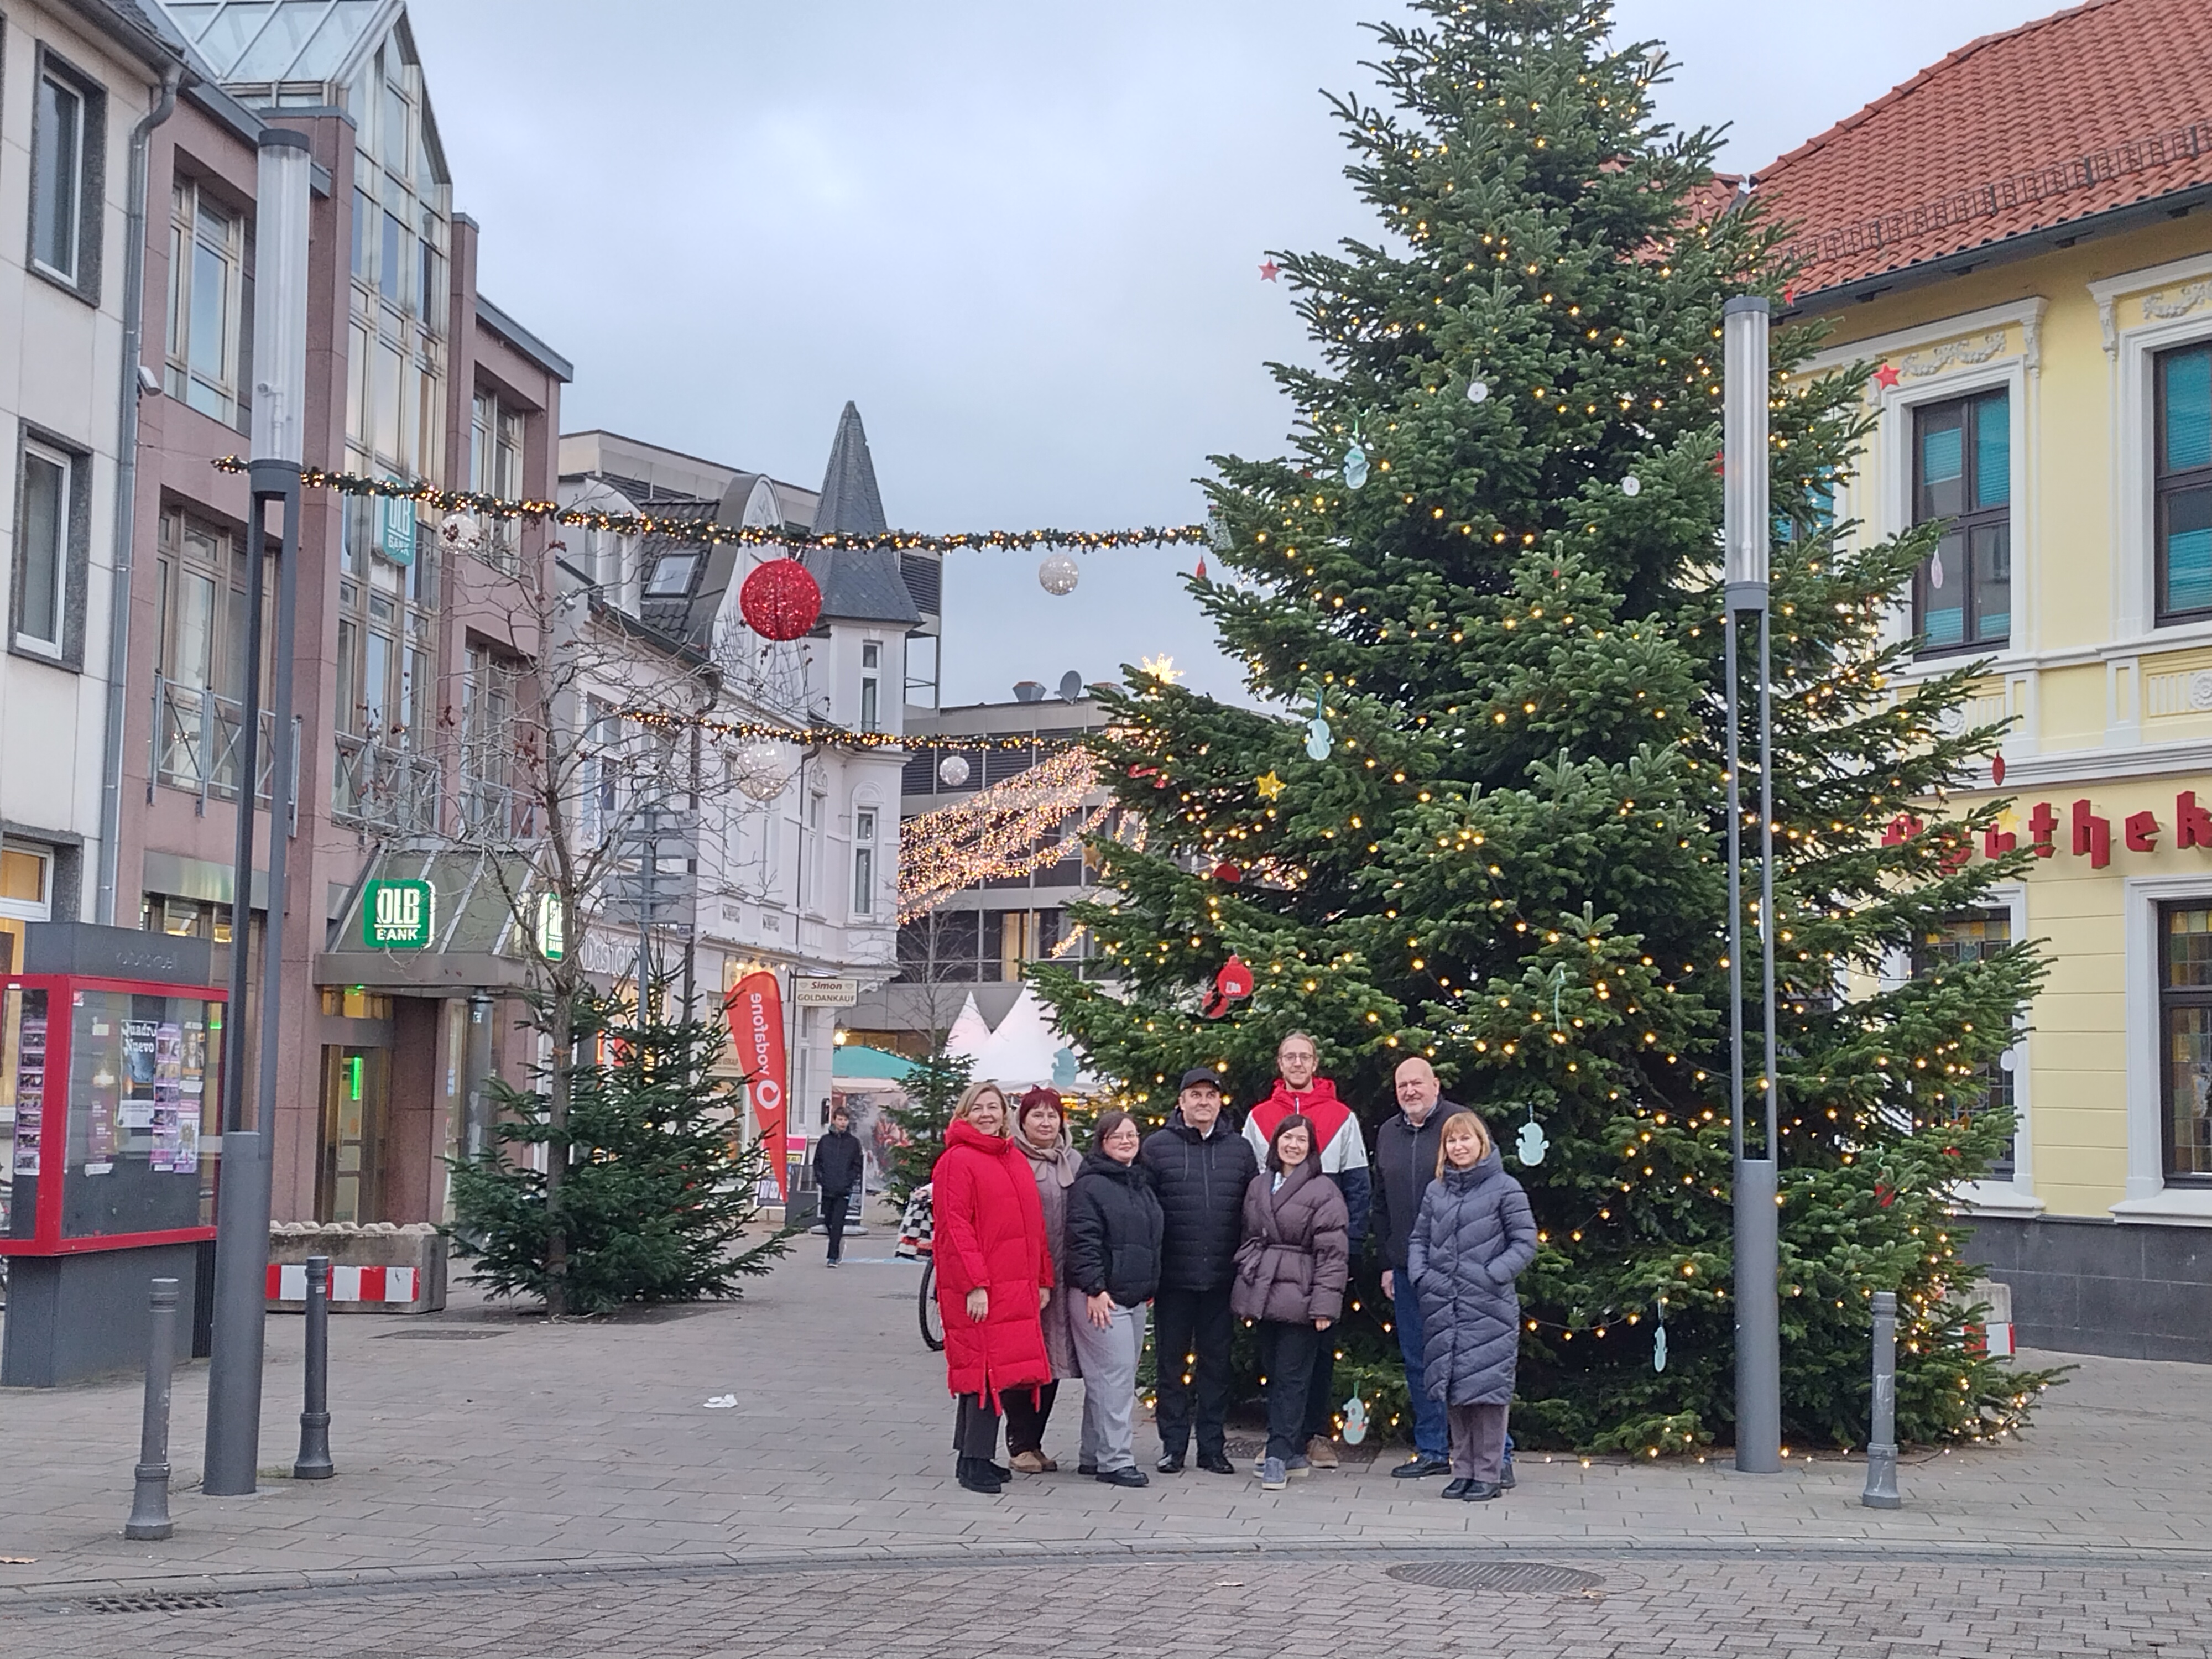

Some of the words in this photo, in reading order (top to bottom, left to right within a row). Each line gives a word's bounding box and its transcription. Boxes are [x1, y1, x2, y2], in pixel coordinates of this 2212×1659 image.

[377, 888, 420, 924] OLB
[376, 928, 418, 941] BANK
[810, 981, 842, 990] Simon
[797, 994, 855, 1003] GOLDANKAUF
[124, 1038, 154, 1053] Nuevo
